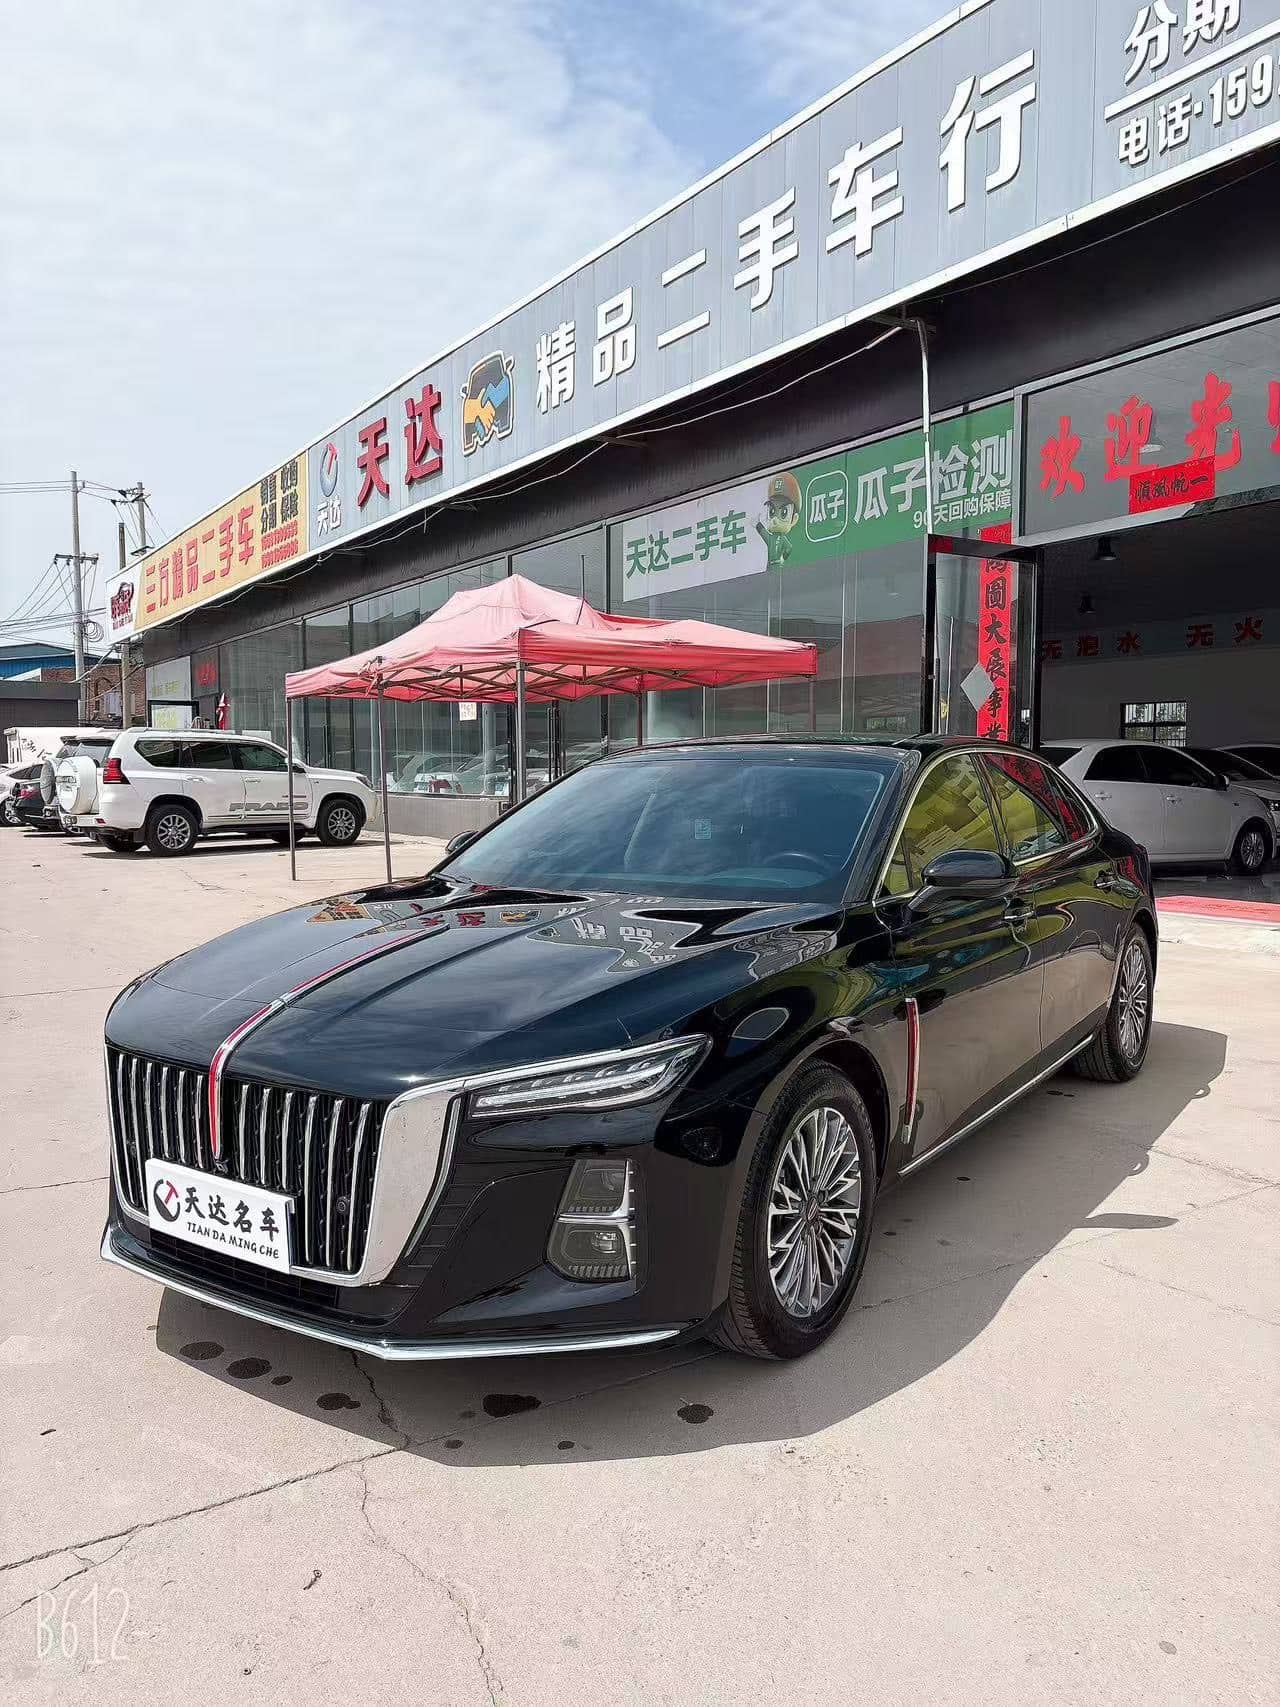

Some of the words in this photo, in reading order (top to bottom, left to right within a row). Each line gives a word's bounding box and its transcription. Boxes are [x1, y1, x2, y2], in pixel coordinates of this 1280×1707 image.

[357, 384, 443, 507] 天达
[536, 49, 1037, 414] 精品二手车行
[1040, 371, 1280, 498] 欢迎光
[809, 491, 845, 525] 瓜子
[853, 430, 1013, 523] 瓜子检测
[626, 509, 747, 579] 天达二手车
[185, 1187, 280, 1242] 天达名车
[187, 1221, 210, 1238] TIAN
[212, 1229, 226, 1243] DA
[229, 1235, 257, 1254] MING
[259, 1245, 280, 1260] CHE
